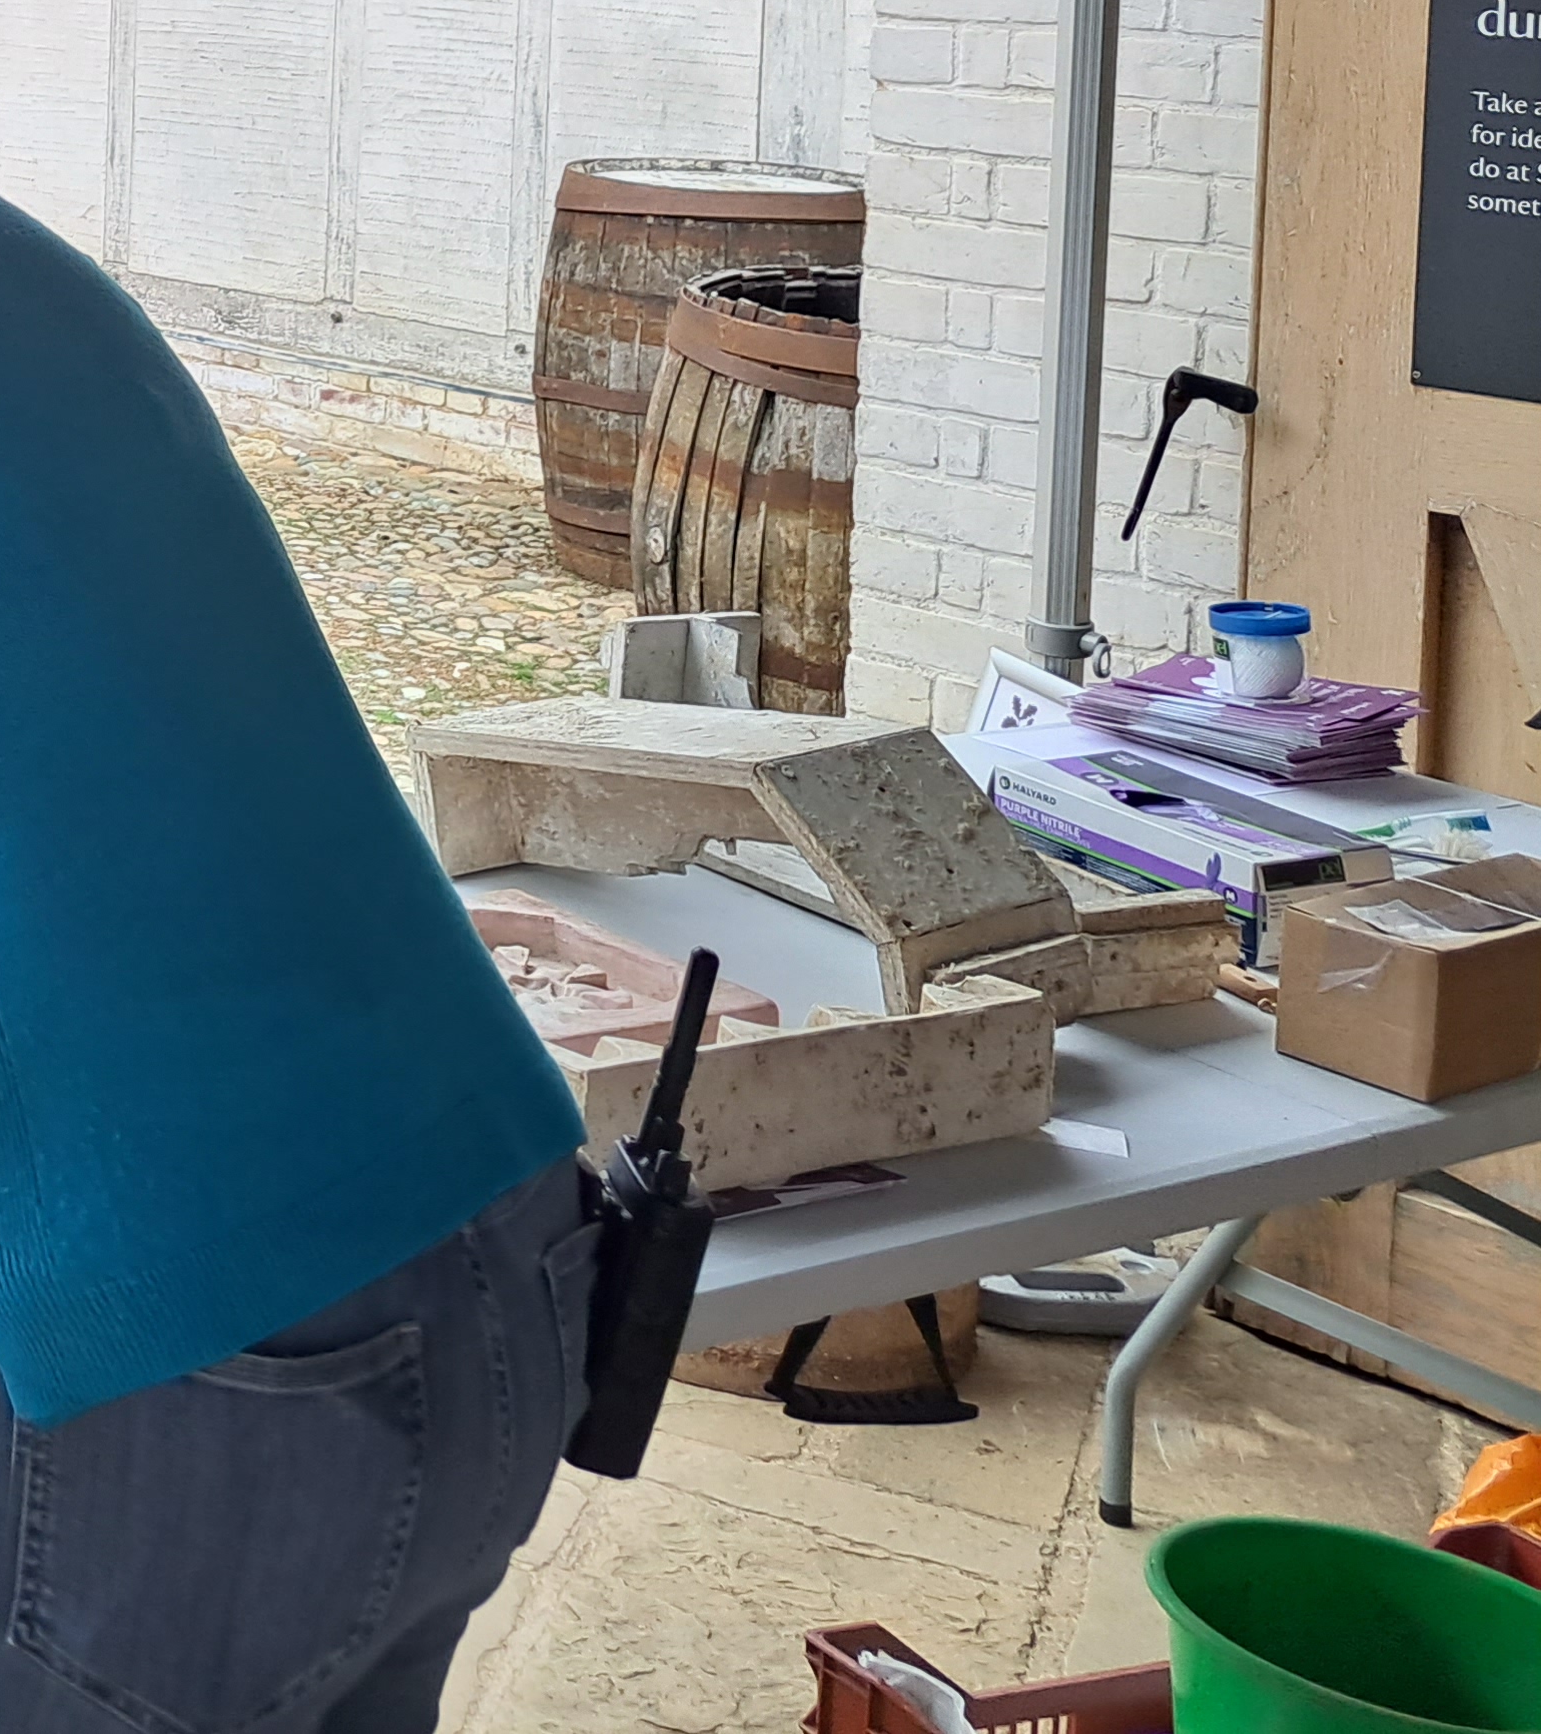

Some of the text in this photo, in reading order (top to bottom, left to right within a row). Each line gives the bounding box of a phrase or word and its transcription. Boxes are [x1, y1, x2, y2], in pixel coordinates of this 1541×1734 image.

[1470, 91, 1528, 114] Take
[1471, 124, 1506, 145] for
[1469, 157, 1500, 178] do
[1507, 165, 1530, 182] at
[1467, 195, 1541, 216] somet
[1012, 782, 1057, 805] HALYARD
[1000, 798, 1040, 821] PURPLE
[1041, 816, 1081, 837] NITRILE
[1226, 891, 1236, 901] M
